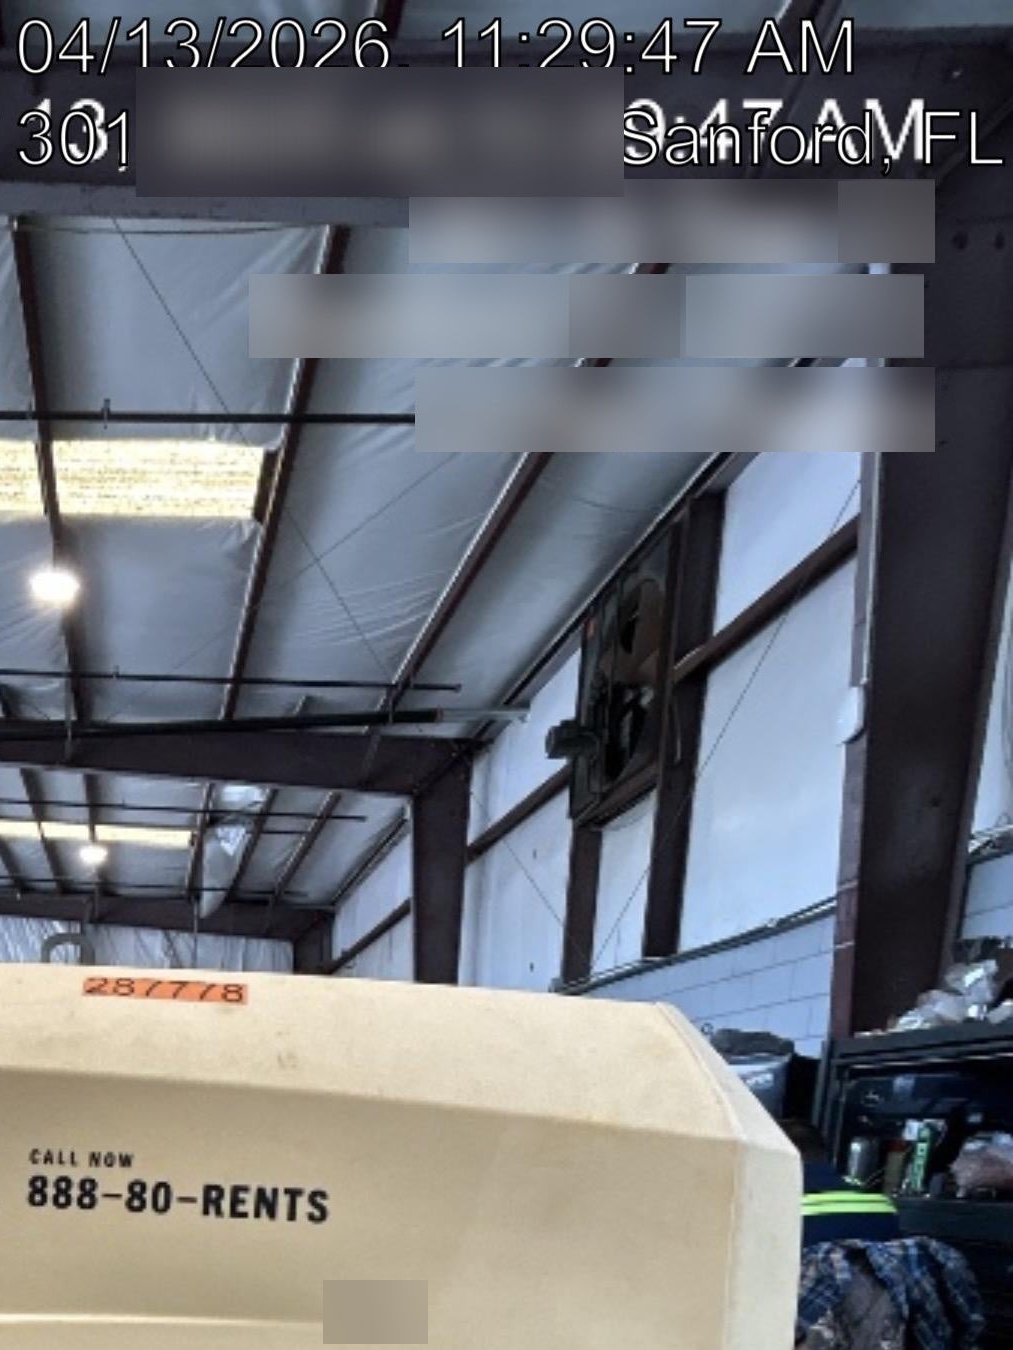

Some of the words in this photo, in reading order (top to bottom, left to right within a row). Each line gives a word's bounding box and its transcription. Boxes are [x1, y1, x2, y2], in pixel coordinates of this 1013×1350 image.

[84, 977, 244, 1003] 287778
[29, 1148, 78, 1167] CALL
[88, 1152, 134, 1168] NOW
[27, 1175, 329, 1224] 888-80-RENTS
